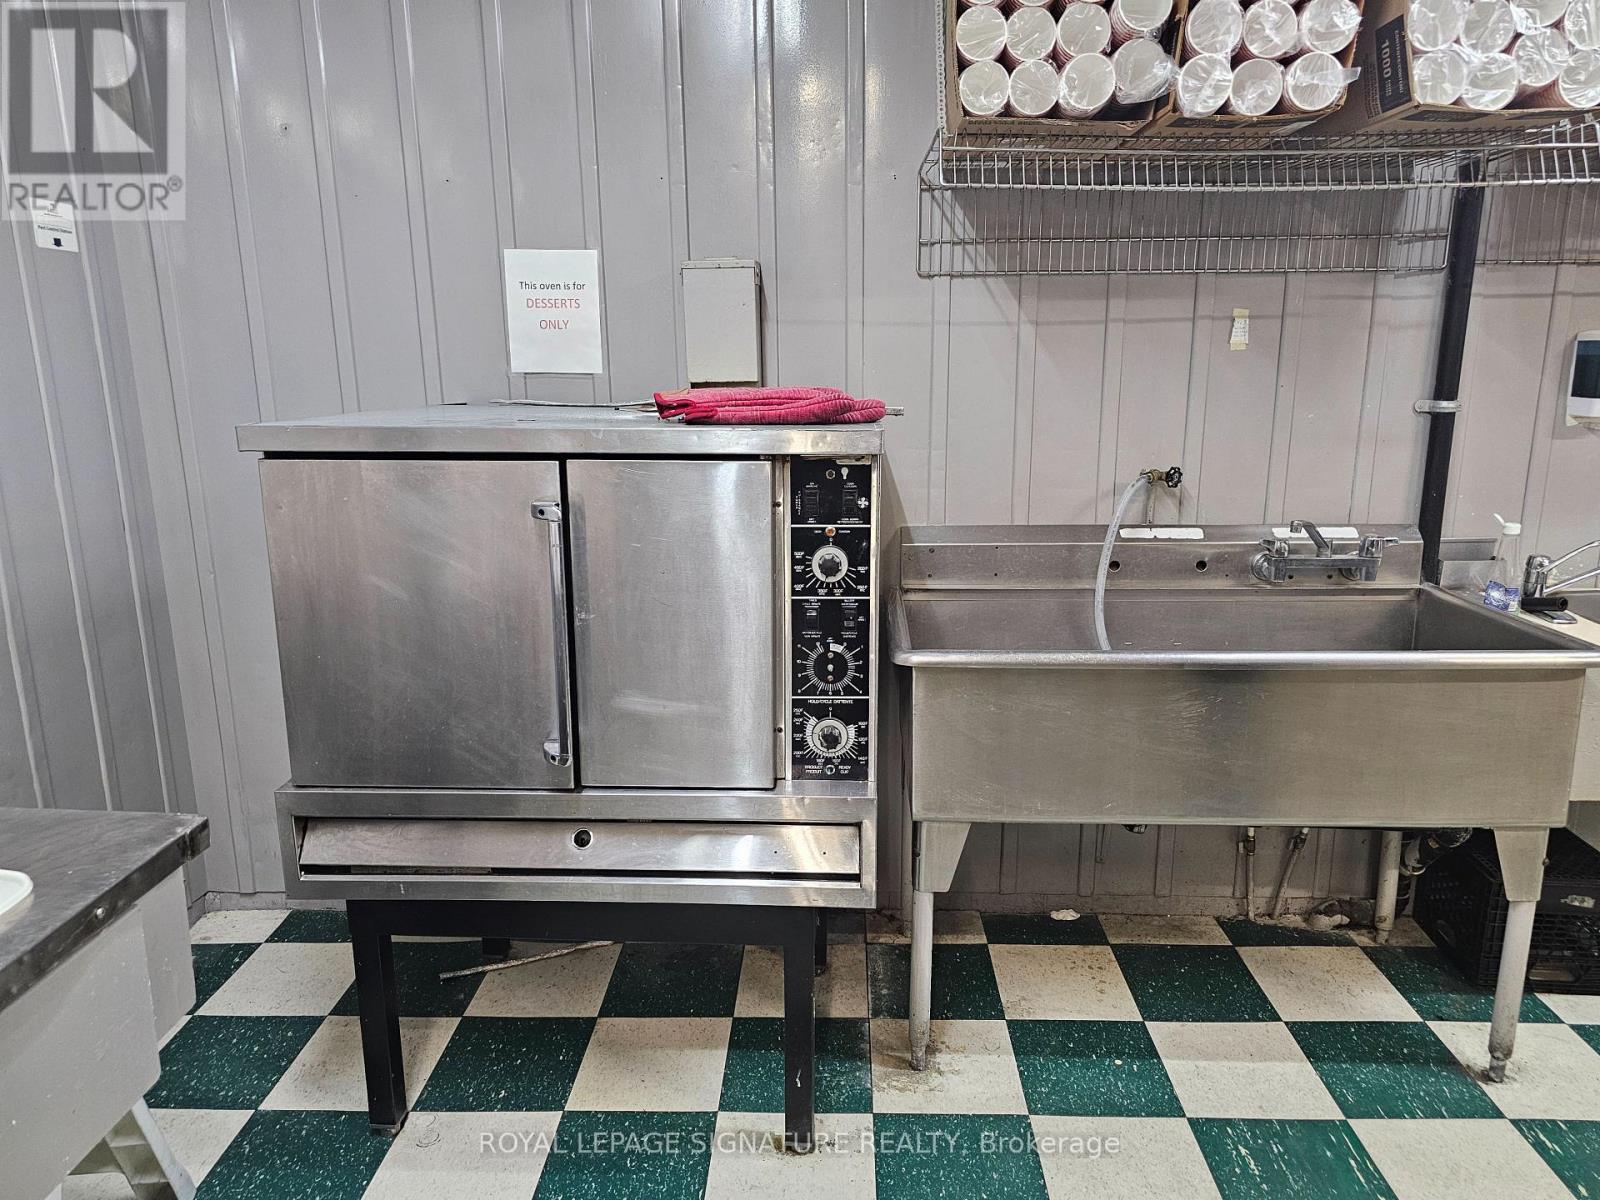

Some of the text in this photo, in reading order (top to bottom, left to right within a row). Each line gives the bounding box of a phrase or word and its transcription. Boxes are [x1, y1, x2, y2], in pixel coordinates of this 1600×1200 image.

[1381, 40, 1392, 78] 1000
[519, 281, 537, 290] This
[563, 282, 571, 290] is
[572, 282, 586, 290] for
[526, 298, 581, 309] DESSERTS
[539, 319, 569, 330] ONLY
